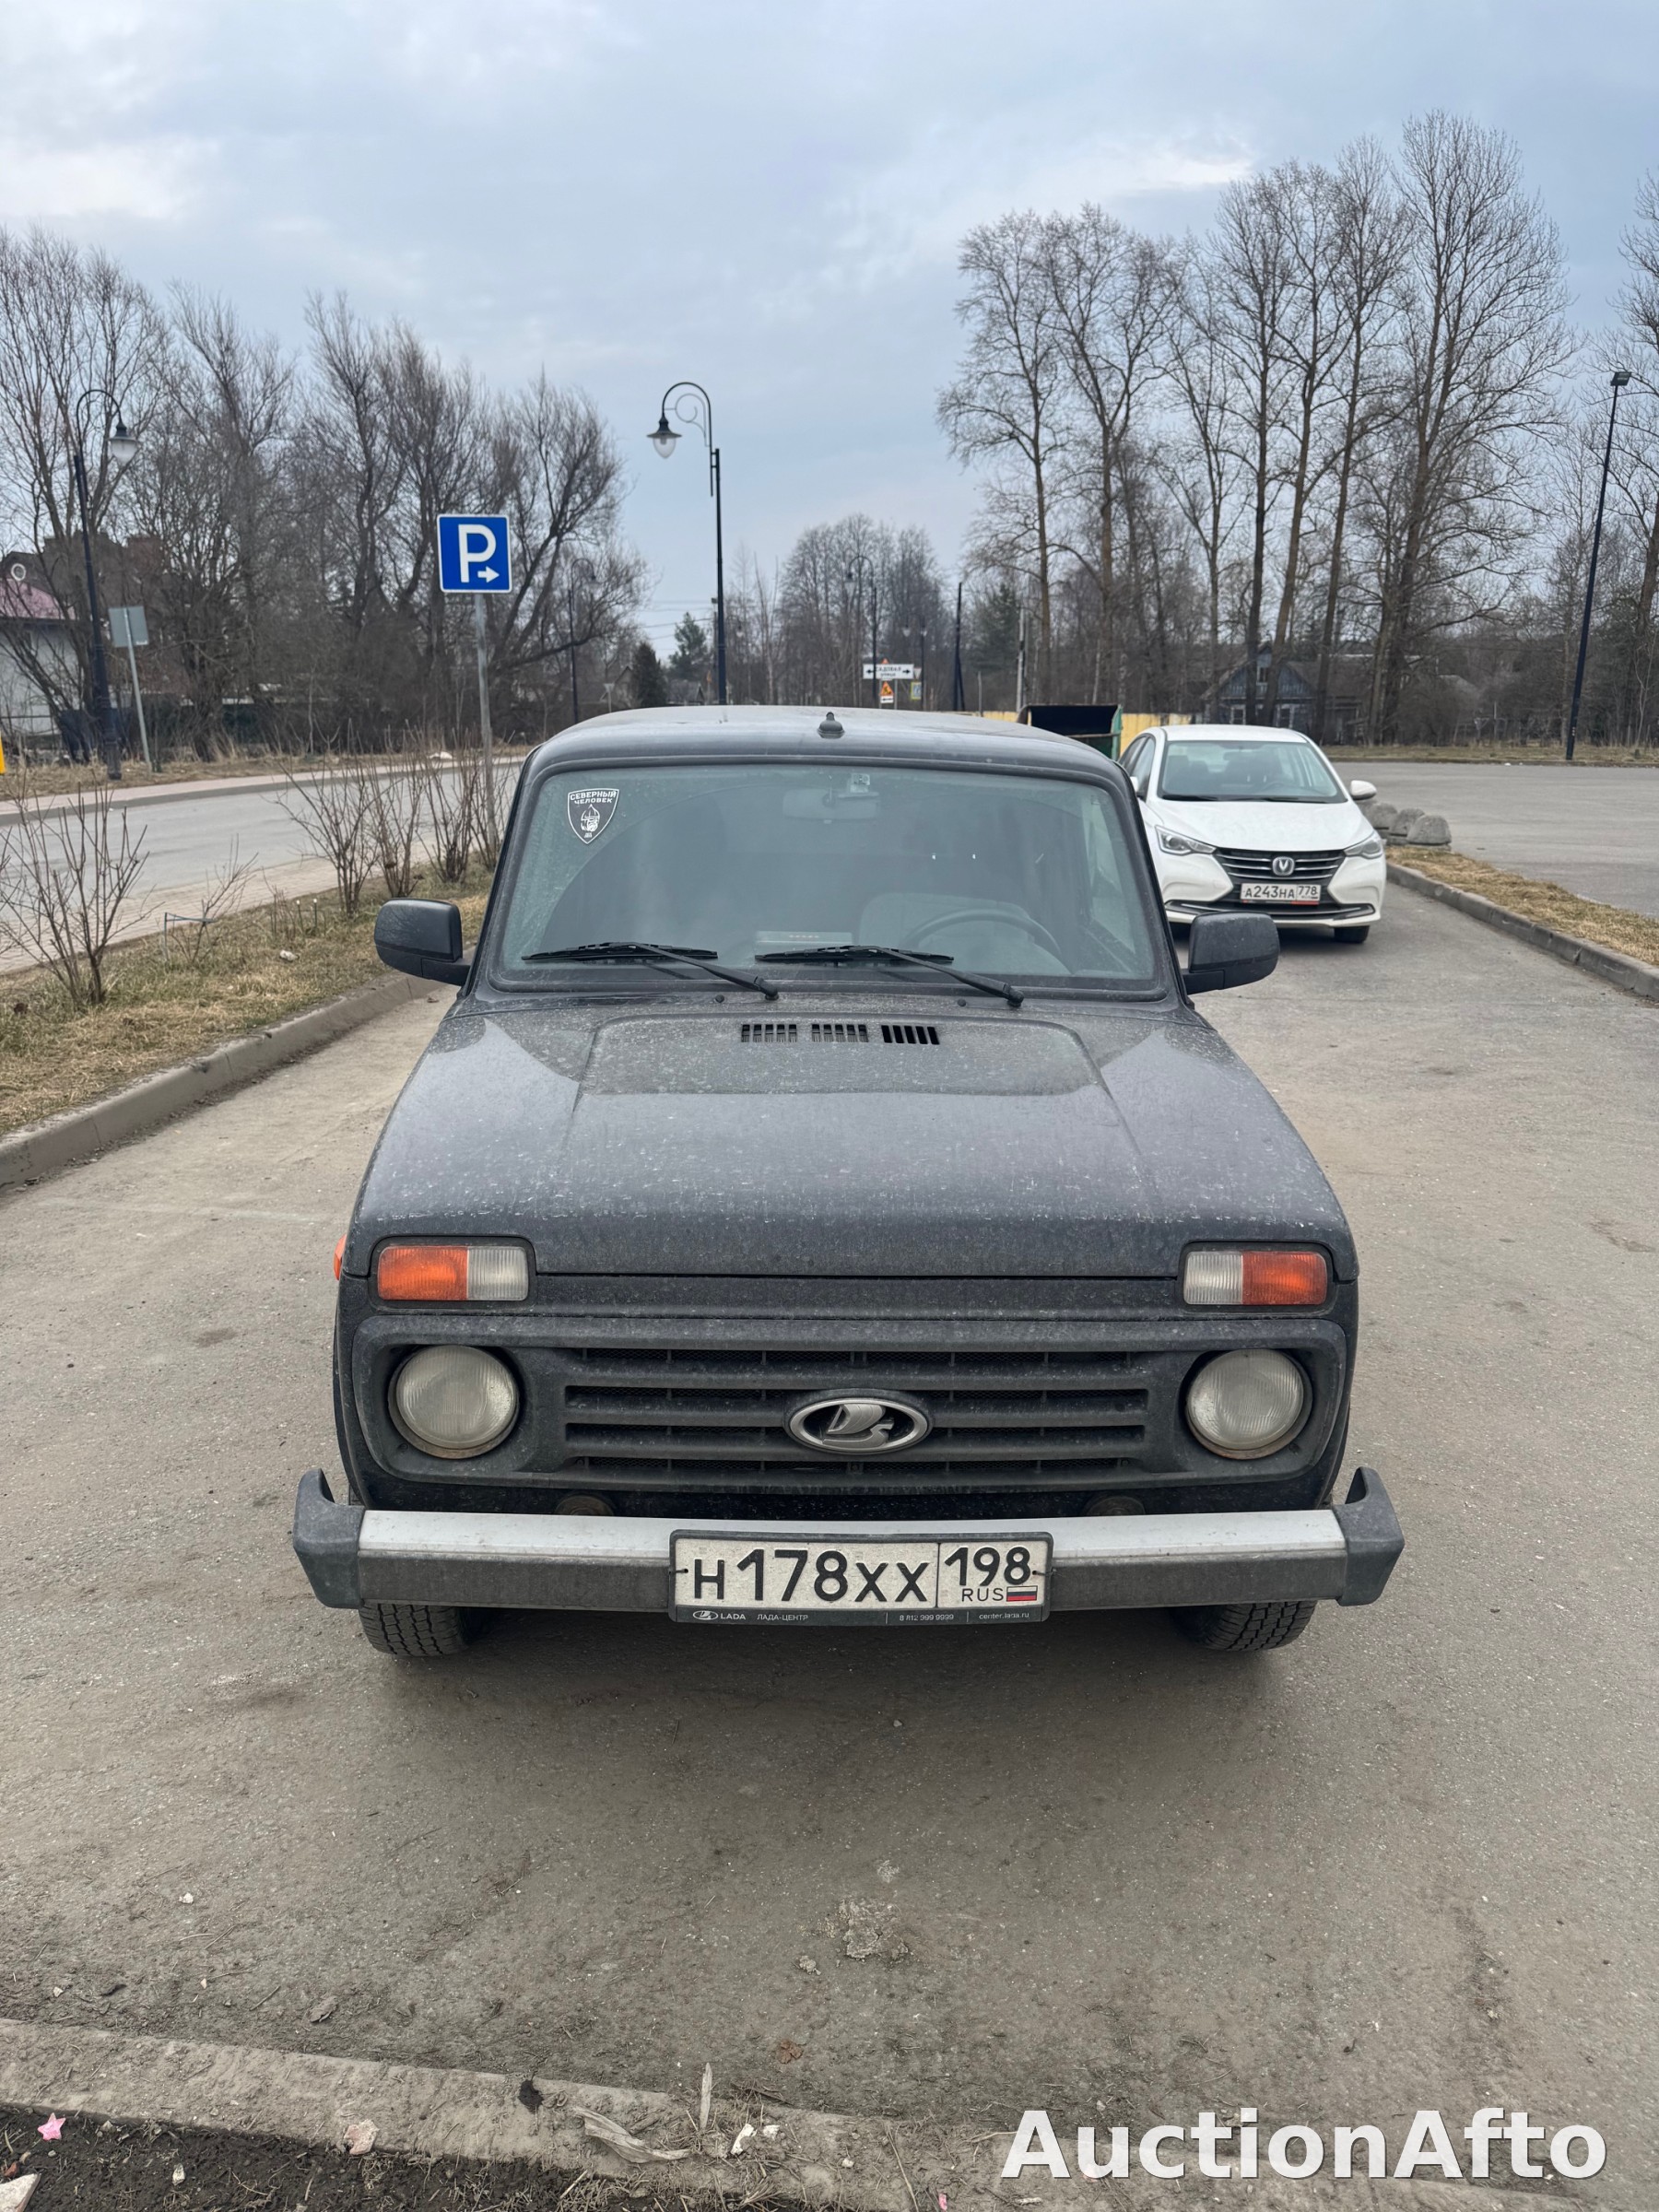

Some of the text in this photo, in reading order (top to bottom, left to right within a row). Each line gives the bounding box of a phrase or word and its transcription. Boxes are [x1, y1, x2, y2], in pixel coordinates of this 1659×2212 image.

[458, 524, 497, 583] P
[570, 790, 617, 801] СЕВЕРНЫЙ
[1244, 885, 1318, 899] А243НА 778
[693, 1547, 1031, 1603] Н178ХХ 198
[961, 1587, 1004, 1602] RUS
